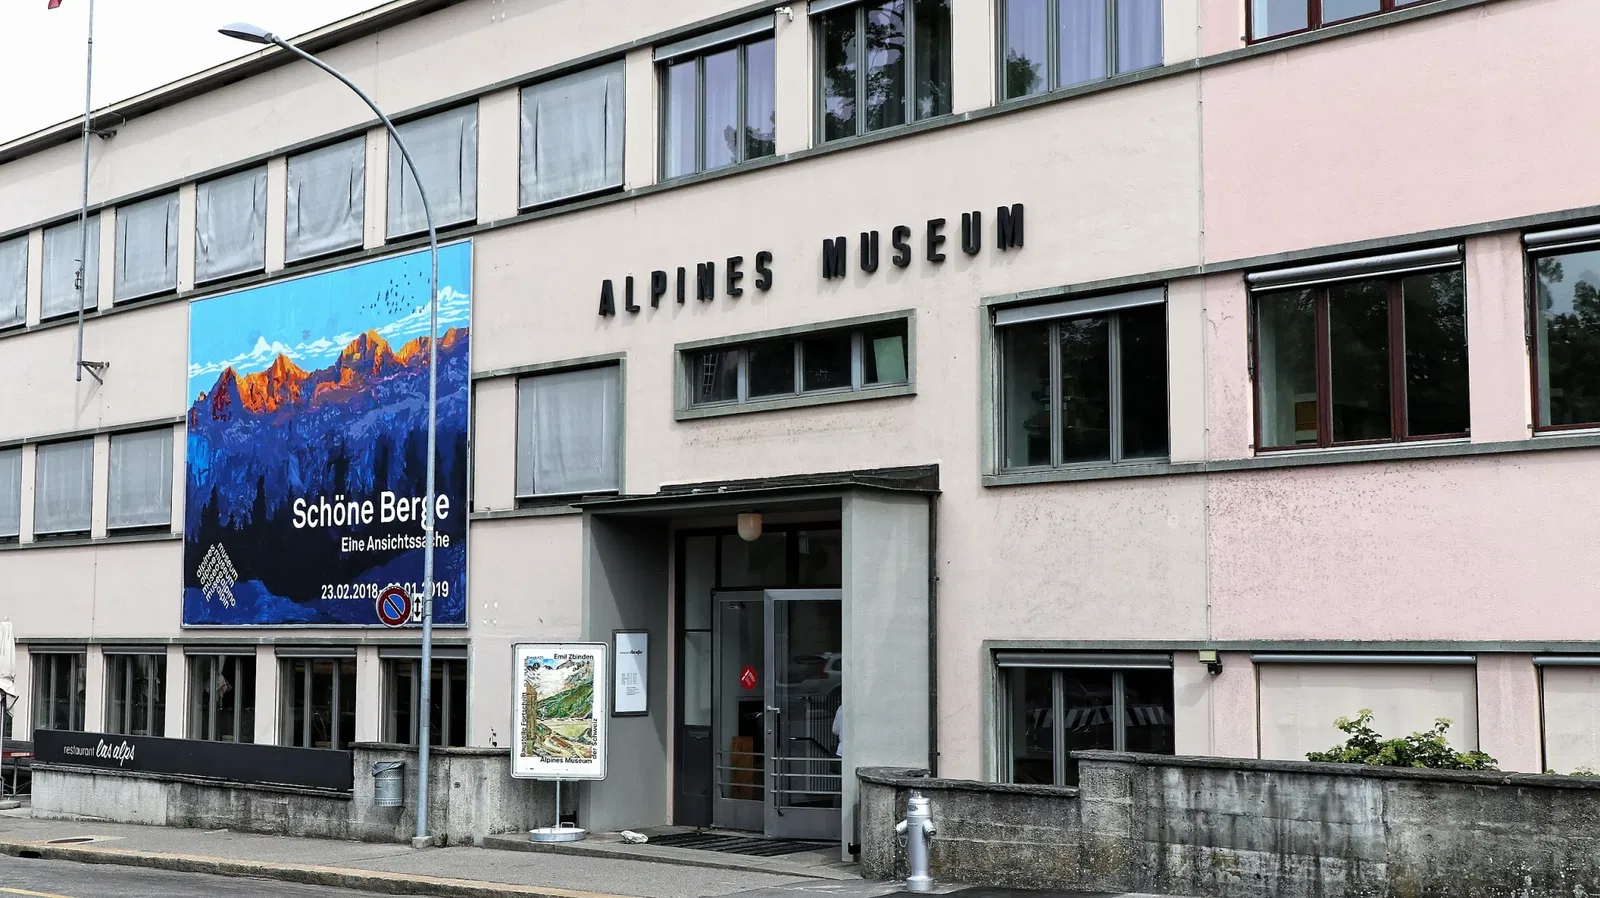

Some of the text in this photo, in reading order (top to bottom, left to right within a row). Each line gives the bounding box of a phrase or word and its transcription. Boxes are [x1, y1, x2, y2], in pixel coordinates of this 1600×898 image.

[598, 203, 1024, 317] ALPINES MUSEUM
[292, 494, 374, 529] Schöne
[341, 531, 450, 552] Eine Ansichtssahe
[197, 542, 238, 581] alpines museum
[200, 549, 234, 588] alpine museum
[202, 563, 236, 607] museo alpino
[590, 718, 598, 747] Schweiz
[63, 745, 95, 757] restaurant
[539, 756, 564, 764] Alpines
